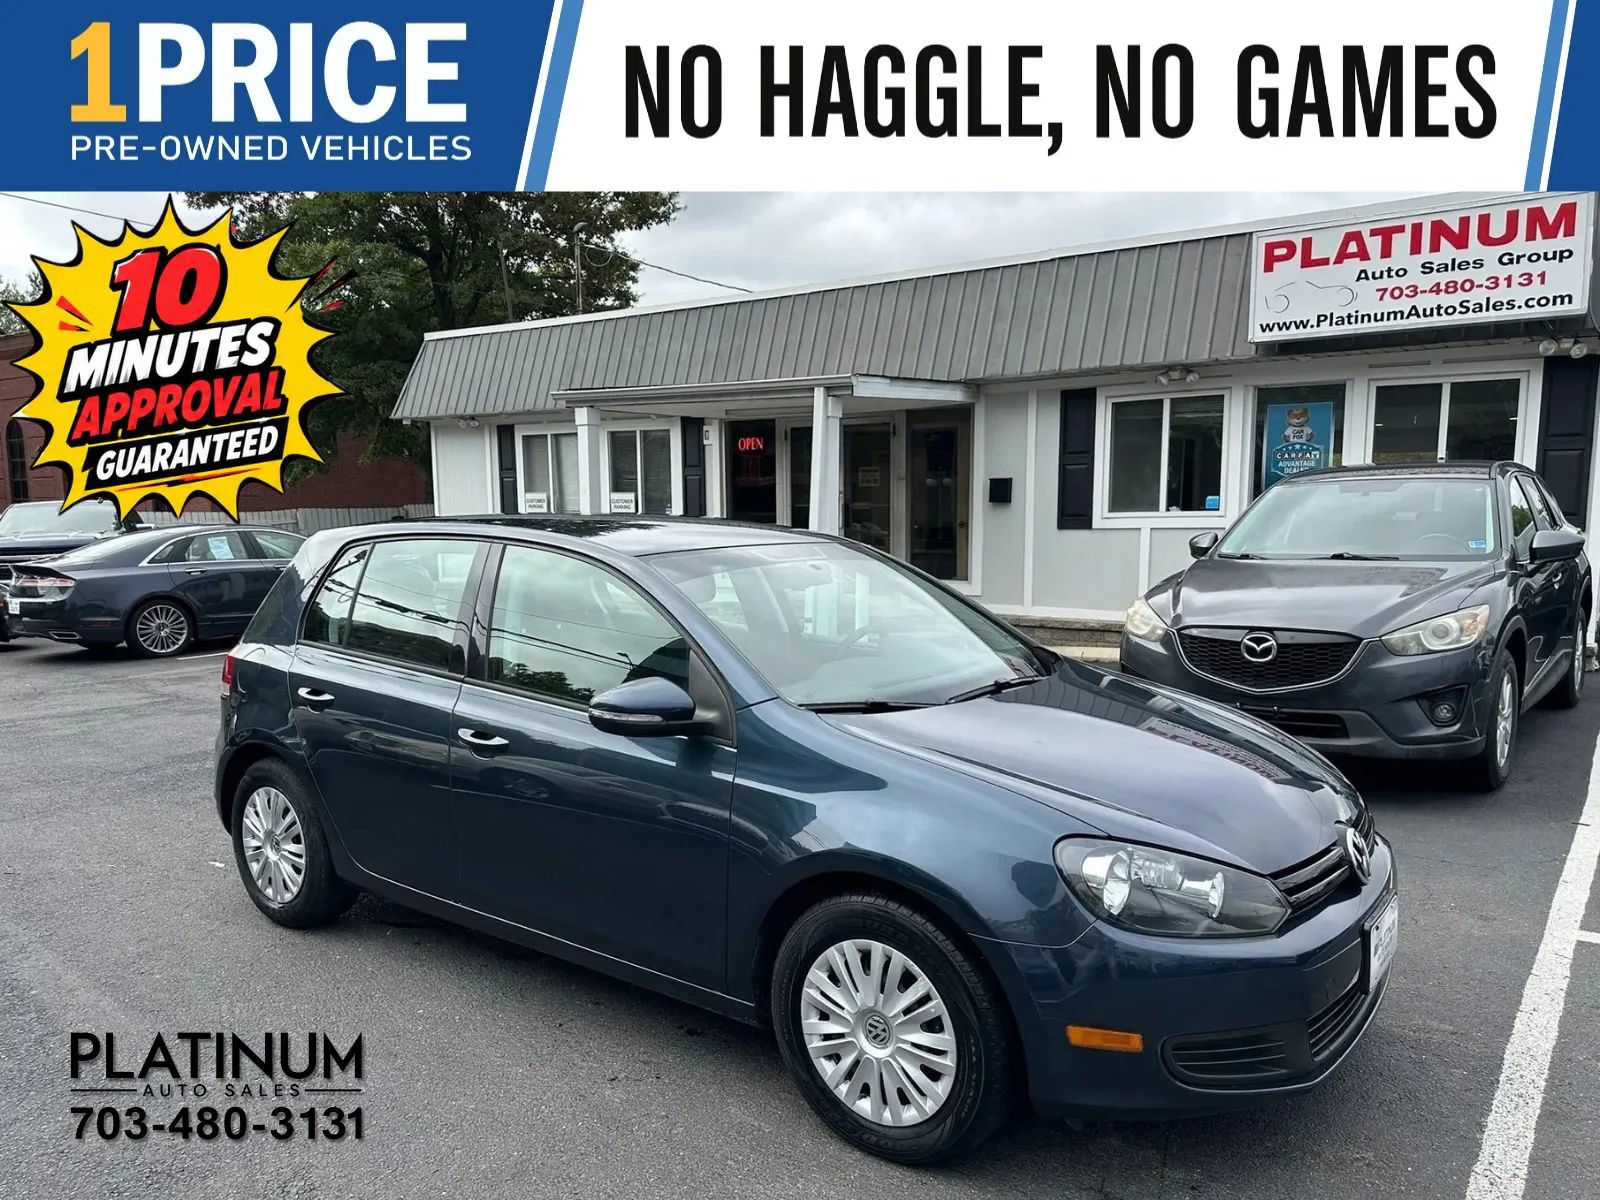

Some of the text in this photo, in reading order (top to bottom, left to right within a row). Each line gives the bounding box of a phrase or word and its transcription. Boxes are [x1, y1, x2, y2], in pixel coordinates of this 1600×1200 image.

[1263, 202, 1577, 273] PLATINUM
[1355, 248, 1574, 282] Auto Sales Group
[1376, 271, 1547, 302] 703-480-3131
[1260, 293, 1573, 333] www.PlatinumAutoSales.com
[738, 437, 763, 451] OPEN
